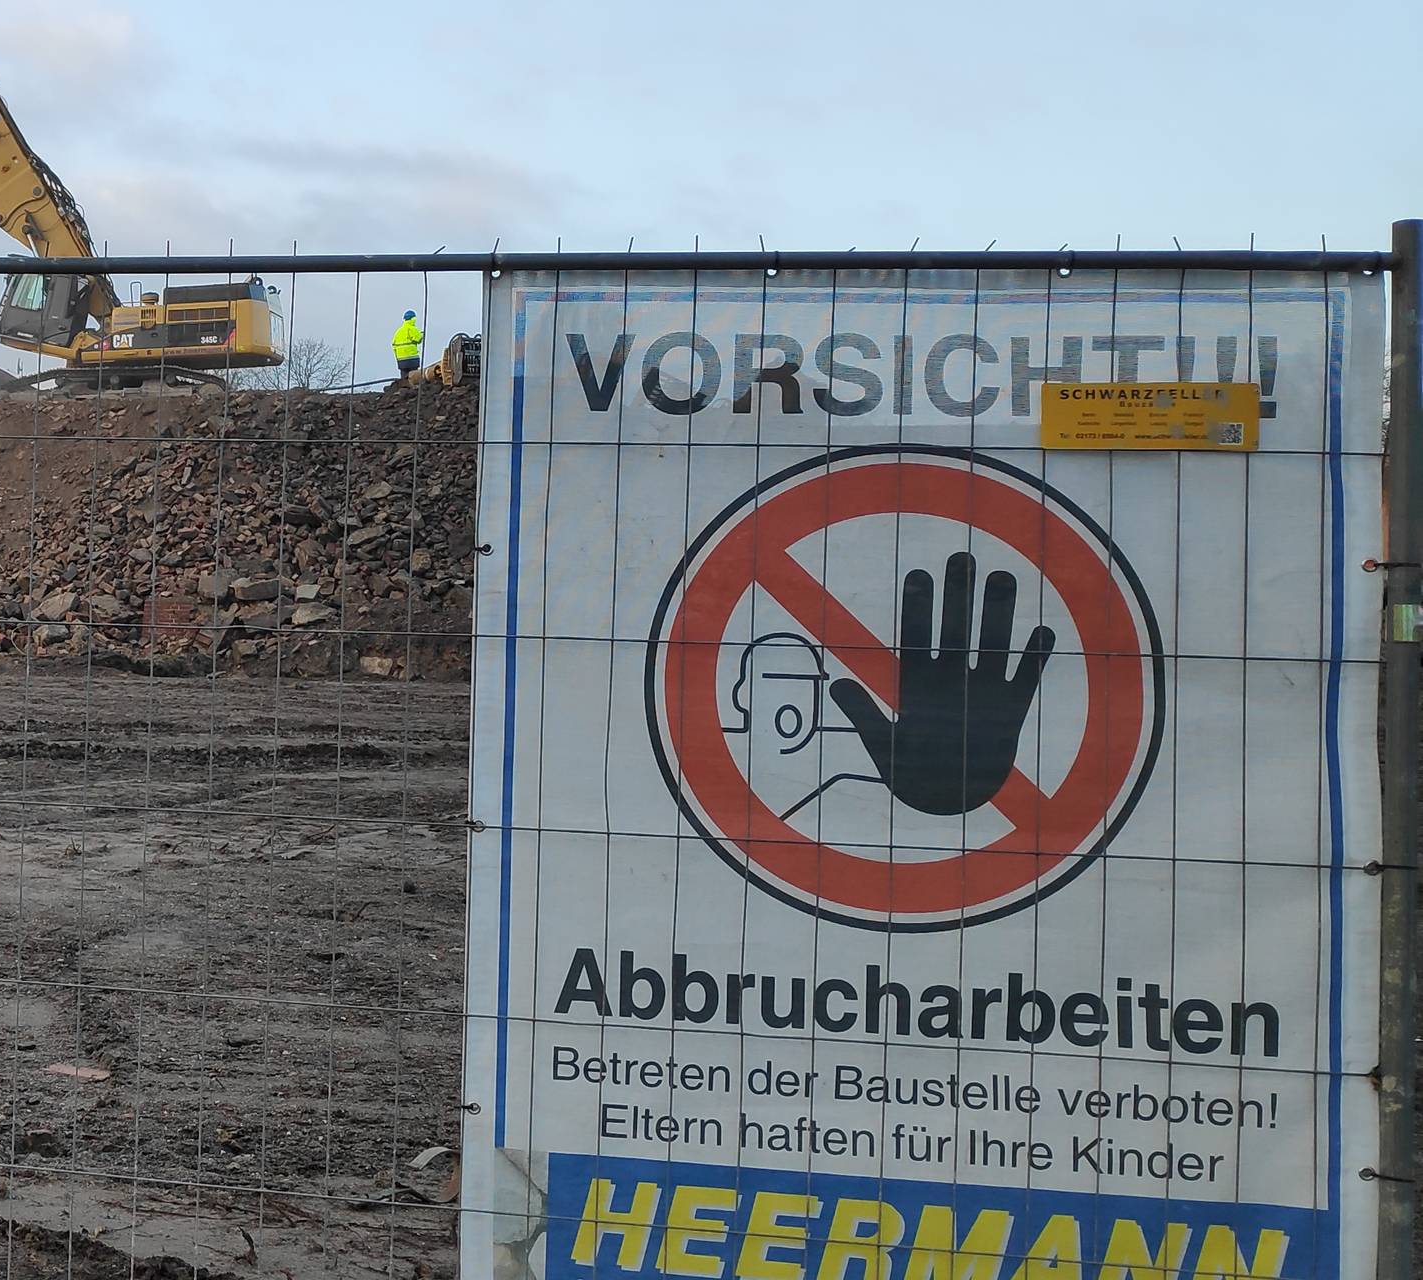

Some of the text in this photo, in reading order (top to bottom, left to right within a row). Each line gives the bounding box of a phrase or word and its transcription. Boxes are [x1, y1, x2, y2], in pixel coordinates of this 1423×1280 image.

[112, 333, 135, 349] CAT
[565, 331, 1278, 418] VORSICHT!!!
[1059, 388, 1224, 400] SCHWARZELL
[553, 947, 1280, 1058] Abbrucharbeiten
[552, 1046, 1278, 1129] Betreten der Baustelle verboten!
[600, 1103, 1225, 1182] Eltern haften für Ihre Kinder
[570, 1178, 1290, 1280] HEERMANN
